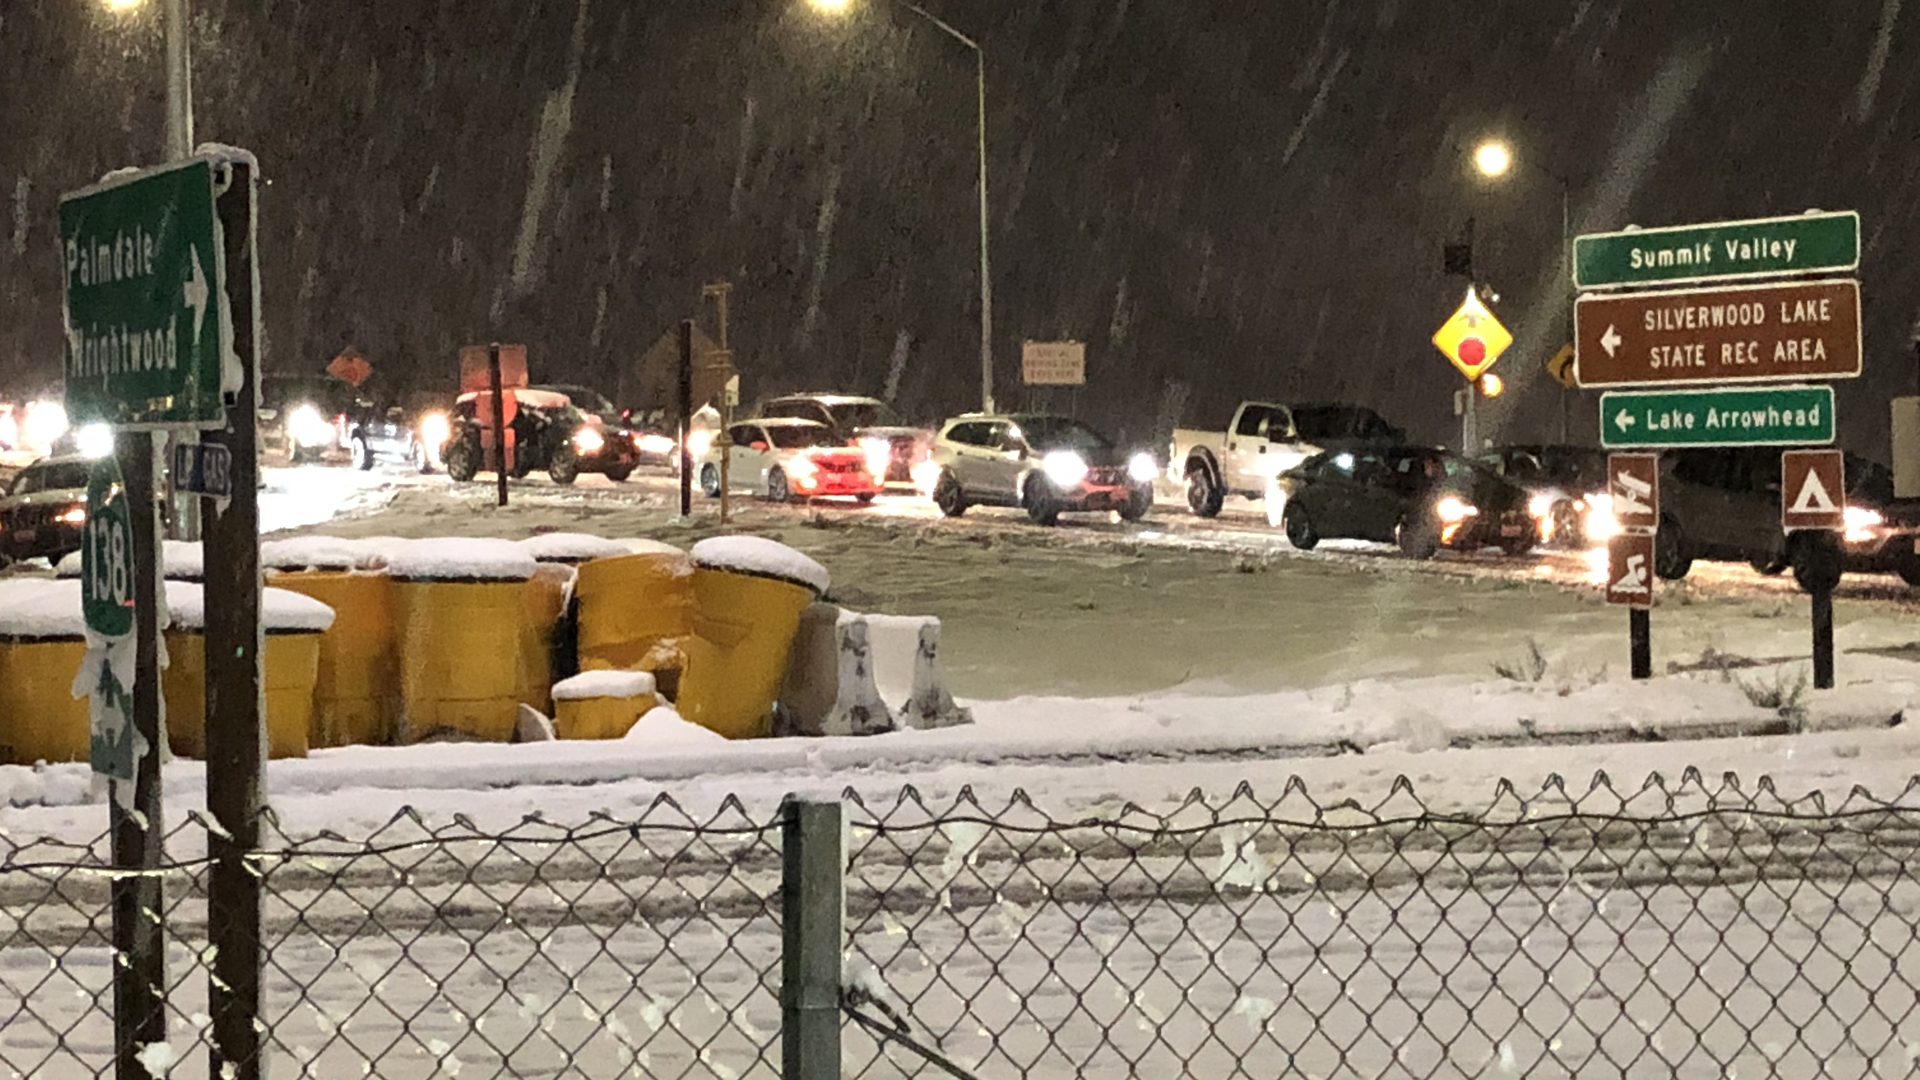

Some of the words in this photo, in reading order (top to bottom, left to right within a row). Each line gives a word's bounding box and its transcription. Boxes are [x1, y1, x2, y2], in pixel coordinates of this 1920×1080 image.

[67, 223, 154, 288] Palmdale
[1630, 243, 1711, 269] Summit
[1725, 238, 1797, 262] Valley
[1645, 303, 1765, 330] SILVERWOOD
[1781, 299, 1831, 322] LAKE
[1650, 345, 1705, 368] STATE
[1721, 341, 1759, 364] REC
[1774, 338, 1826, 362] AREA
[1647, 409, 1695, 429] Lake
[1706, 404, 1819, 429] Arrowhead
[89, 516, 127, 606] 138
